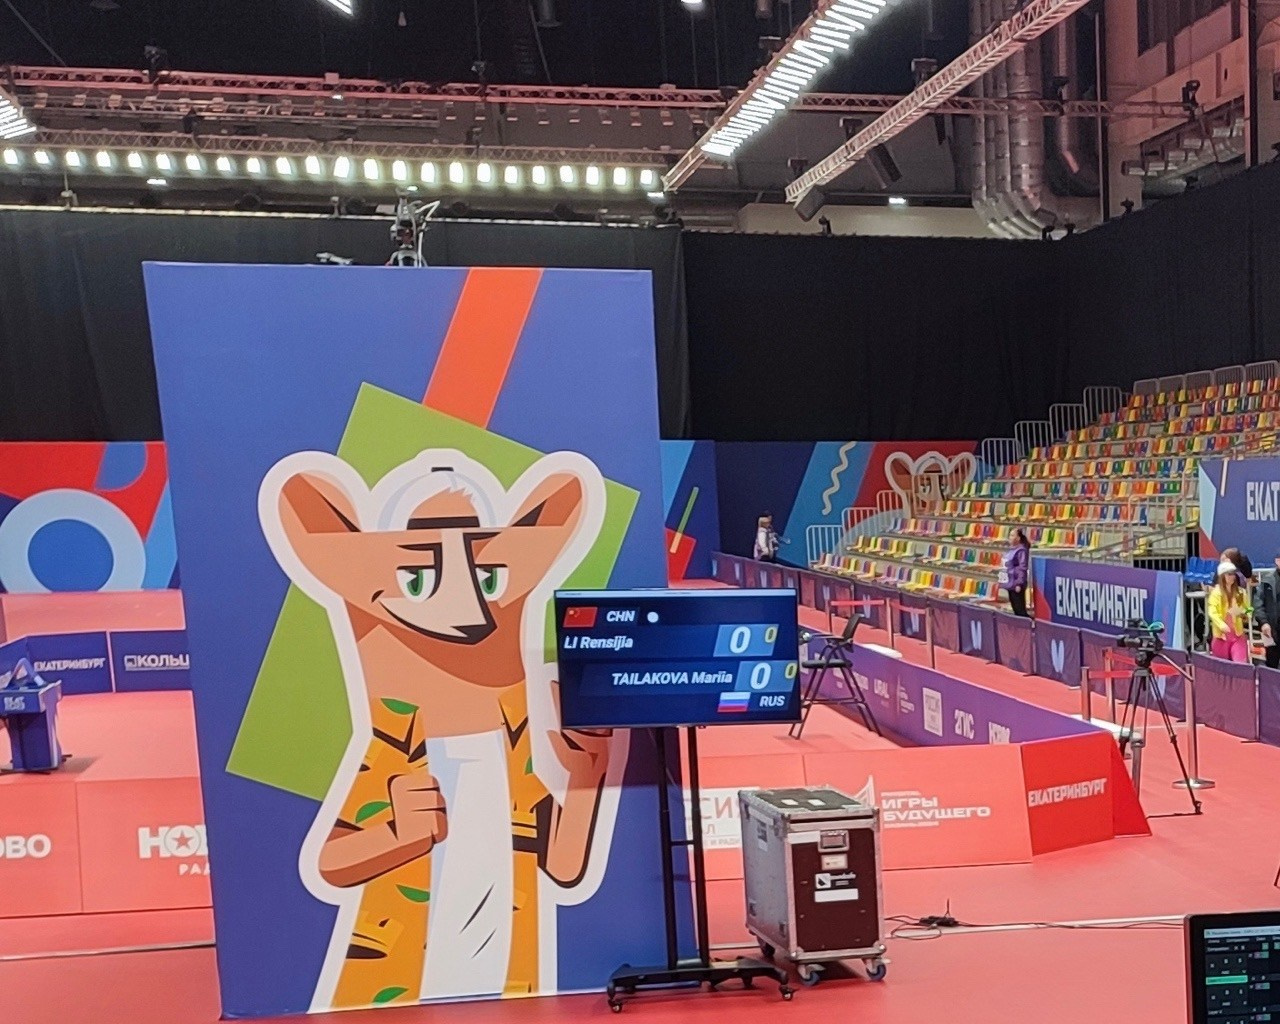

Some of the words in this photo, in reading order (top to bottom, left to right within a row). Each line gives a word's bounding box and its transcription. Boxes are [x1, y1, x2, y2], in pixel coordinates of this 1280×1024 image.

[1054, 575, 1148, 627] ЕКАТЕРИНБУРГ
[606, 610, 635, 622] CHN
[564, 636, 577, 648] LI
[730, 626, 751, 653] 0
[764, 626, 777, 643] 0
[612, 671, 689, 685] TAILAKOVA
[751, 662, 771, 690] 0
[760, 696, 785, 707] RUS
[1029, 778, 1108, 807] ЕКАТЕРИНБУРГ
[881, 797, 938, 809] ИГРЫ
[883, 806, 991, 822] БУДУЩЕГО
[0, 834, 51, 859] ВО
